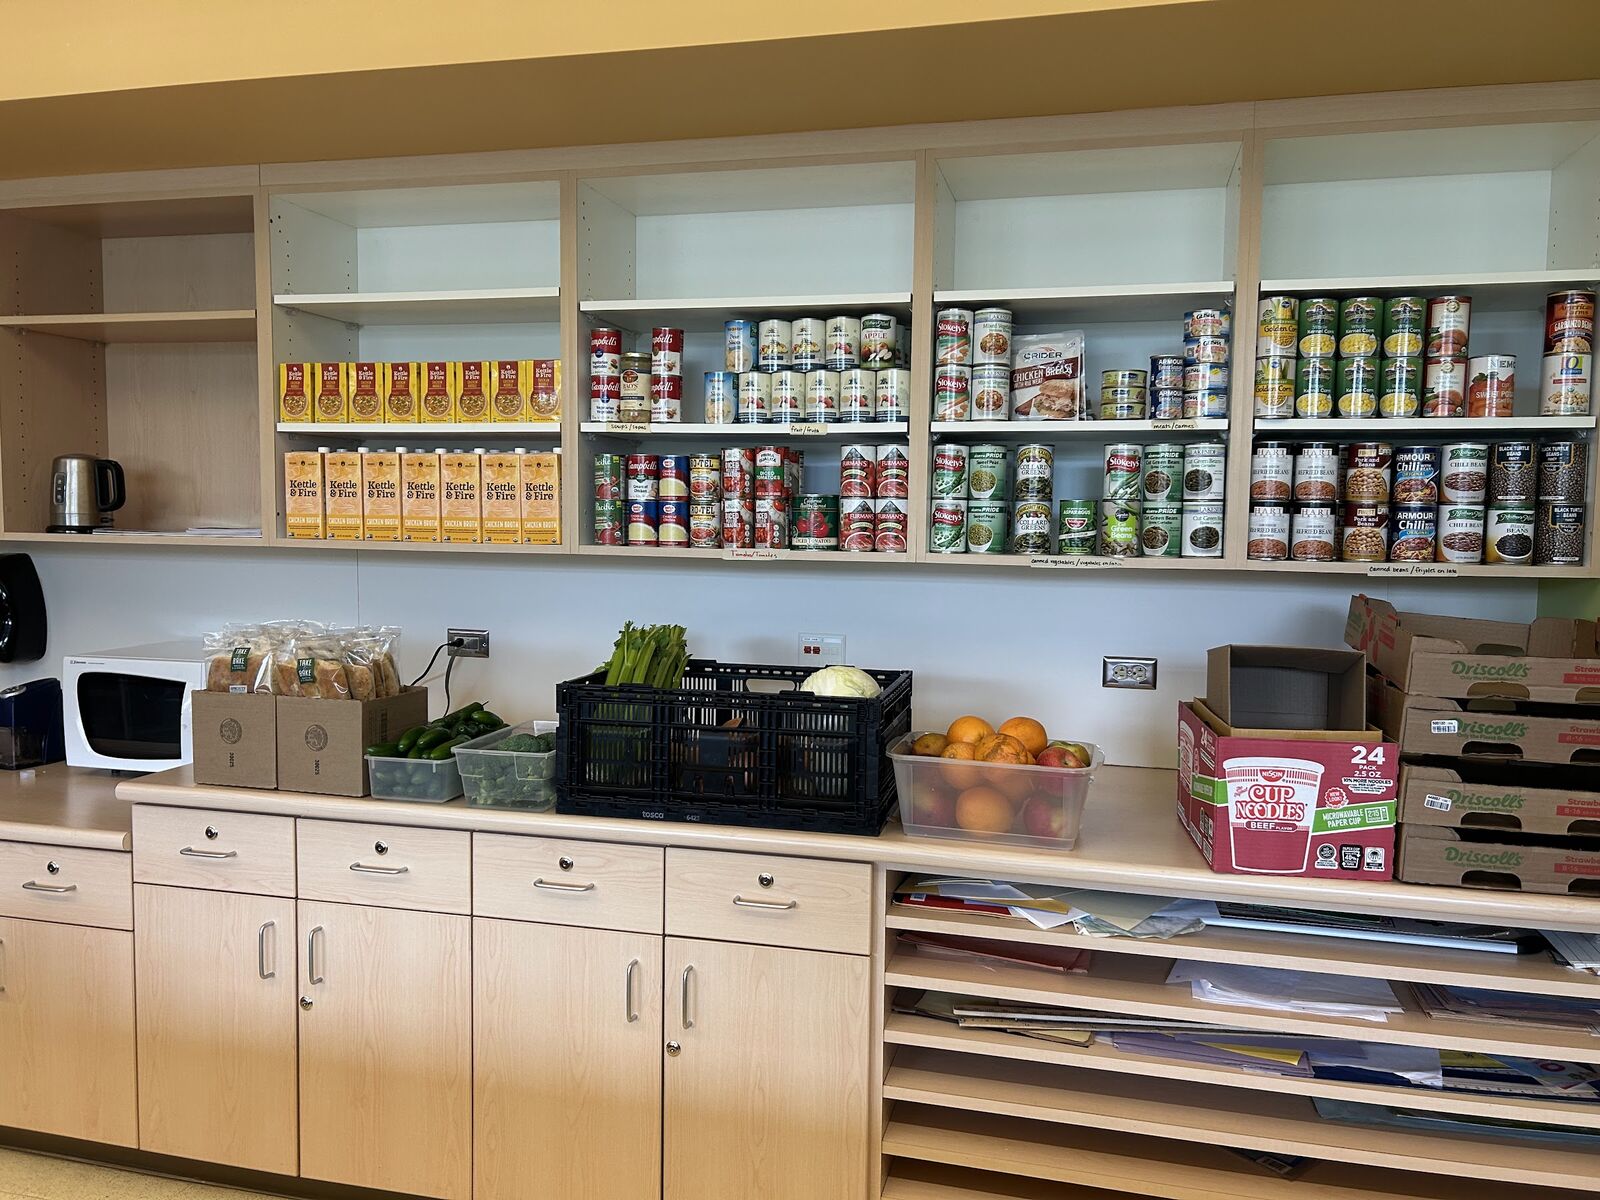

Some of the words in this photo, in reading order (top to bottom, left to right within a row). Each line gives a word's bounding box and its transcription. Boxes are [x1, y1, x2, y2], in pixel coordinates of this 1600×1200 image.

[938, 323, 966, 332] Stokely's
[1566, 356, 1579, 369] O
[1013, 369, 1044, 382] CHICKEN
[938, 378, 966, 389] Stokely's
[936, 456, 963, 467] Stokely's
[1110, 457, 1140, 467] Stokely's
[1397, 462, 1420, 472] Chili
[290, 480, 317, 488] Kettle
[330, 480, 357, 489] Kettle
[368, 481, 395, 490] Kettle
[407, 482, 434, 490] Kettle
[446, 482, 474, 490] Kettle
[486, 482, 516, 491] Kettle
[526, 483, 554, 492] Kettle
[298, 488, 317, 496] Fire
[330, 490, 336, 498] &
[338, 490, 357, 498] Fire
[368, 490, 374, 498] &
[376, 490, 396, 498] Fire
[407, 491, 414, 499] &
[416, 490, 434, 499] Fire
[446, 492, 452, 500] &
[455, 491, 475, 500] Fire
[487, 492, 494, 500] &
[496, 492, 516, 500] Fire
[526, 492, 532, 500] &
[534, 492, 554, 500] Fire
[934, 511, 962, 521] Stokely's
[1399, 520, 1424, 530] Chili
[1451, 660, 1532, 678] Driscoll's
[1351, 745, 1385, 765] 24
[1248, 784, 1295, 803] CUP
[1446, 789, 1526, 809] Driscoll's
[642, 810, 664, 819] tosca
[1235, 801, 1304, 821] NOODLES
[1322, 809, 1364, 821] MICROWAVABLE
[1327, 819, 1348, 828] PAPER
[1444, 847, 1523, 866] Driscoll's
